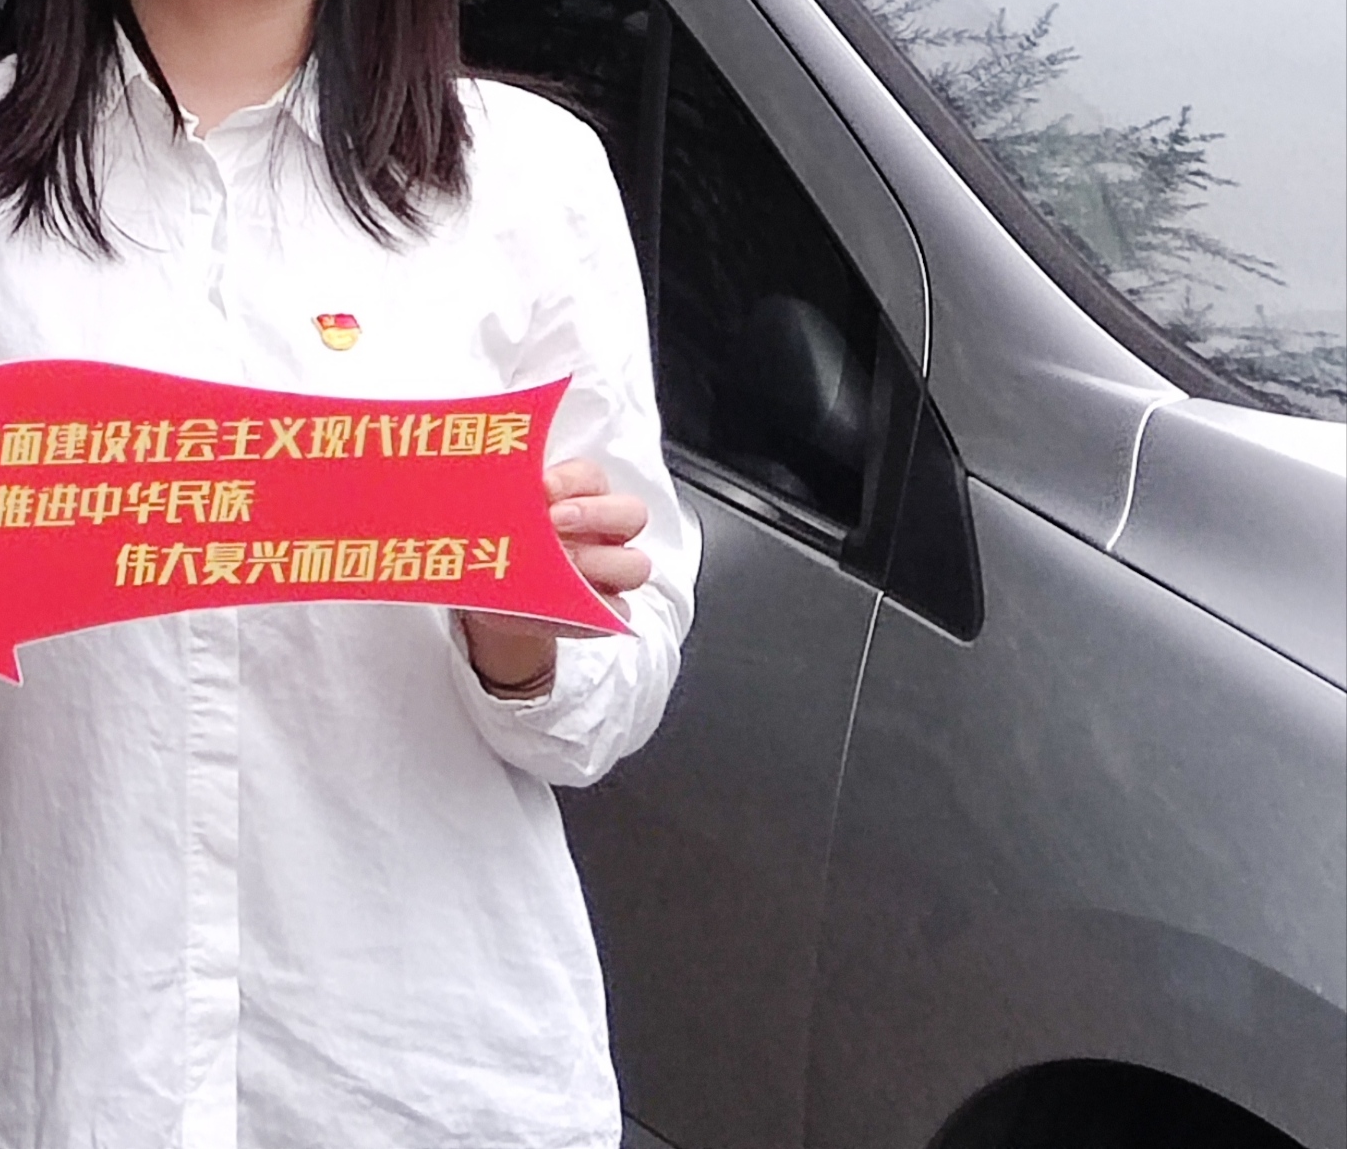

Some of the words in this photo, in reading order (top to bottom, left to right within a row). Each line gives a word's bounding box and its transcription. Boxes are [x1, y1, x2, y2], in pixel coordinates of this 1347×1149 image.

[114, 536, 511, 587] 伟大复兴而团结奋斗
